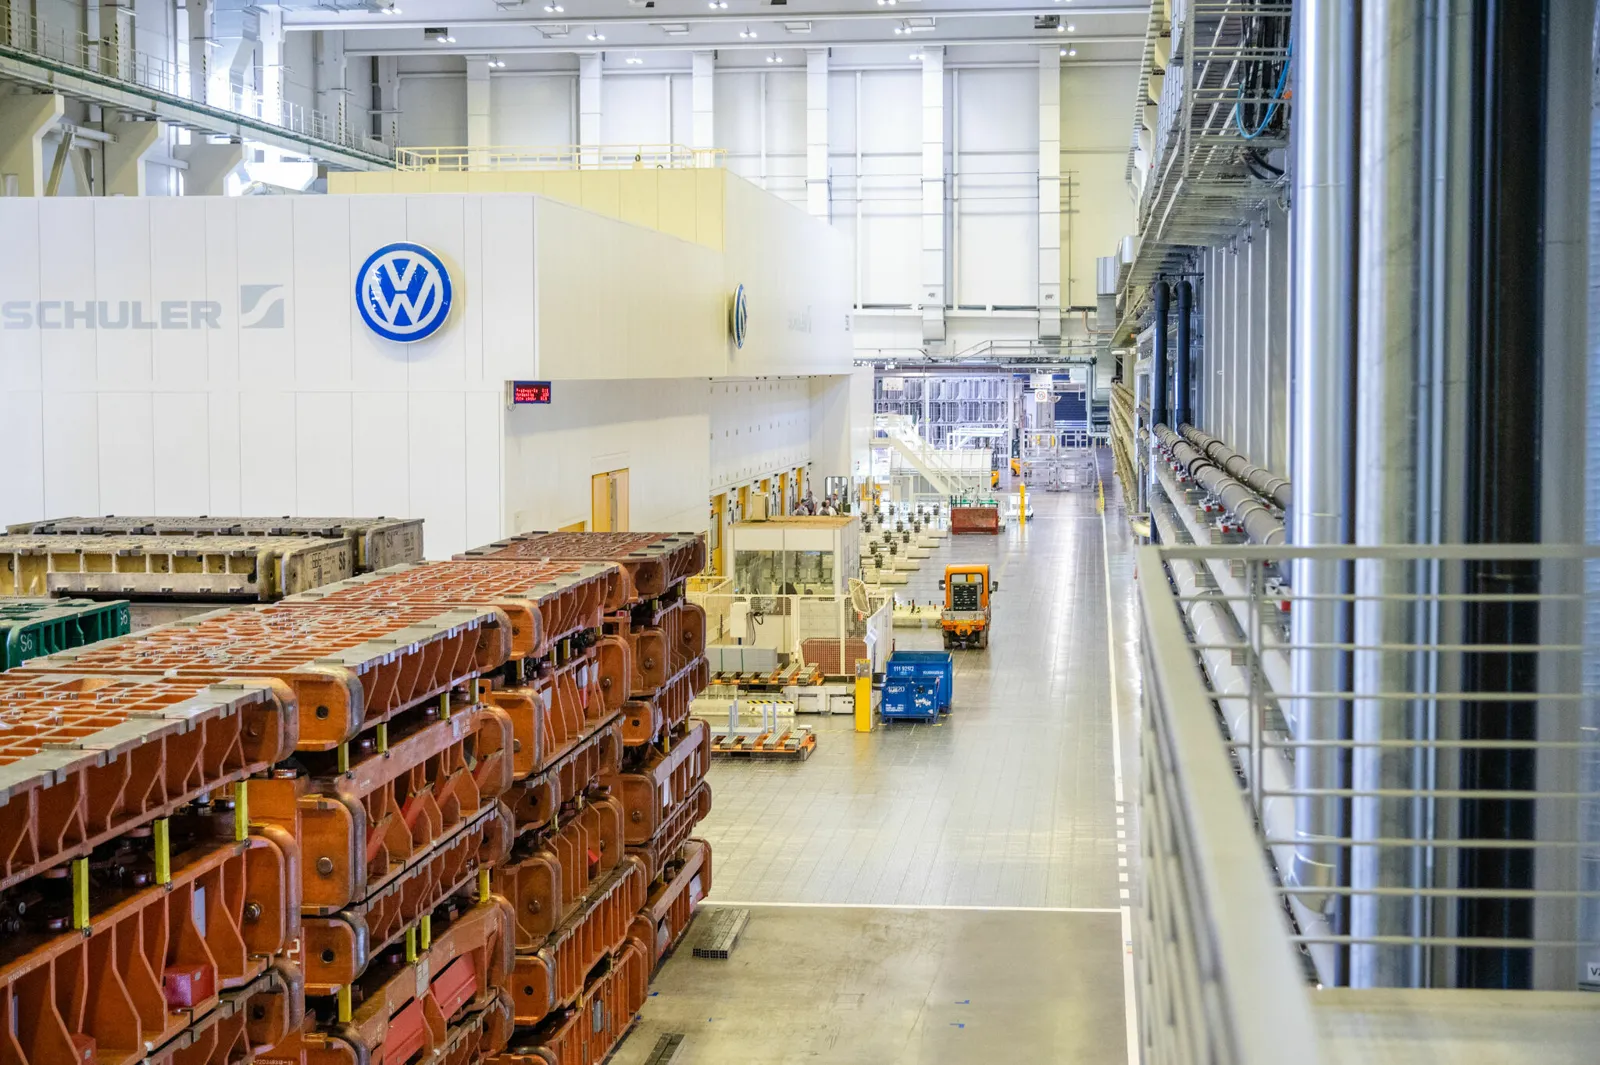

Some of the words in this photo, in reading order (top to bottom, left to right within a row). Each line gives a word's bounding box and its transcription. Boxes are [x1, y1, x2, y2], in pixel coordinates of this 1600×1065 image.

[362, 250, 444, 333] VW
[1, 300, 222, 329] SCHULER
[20, 633, 33, 653] S6
